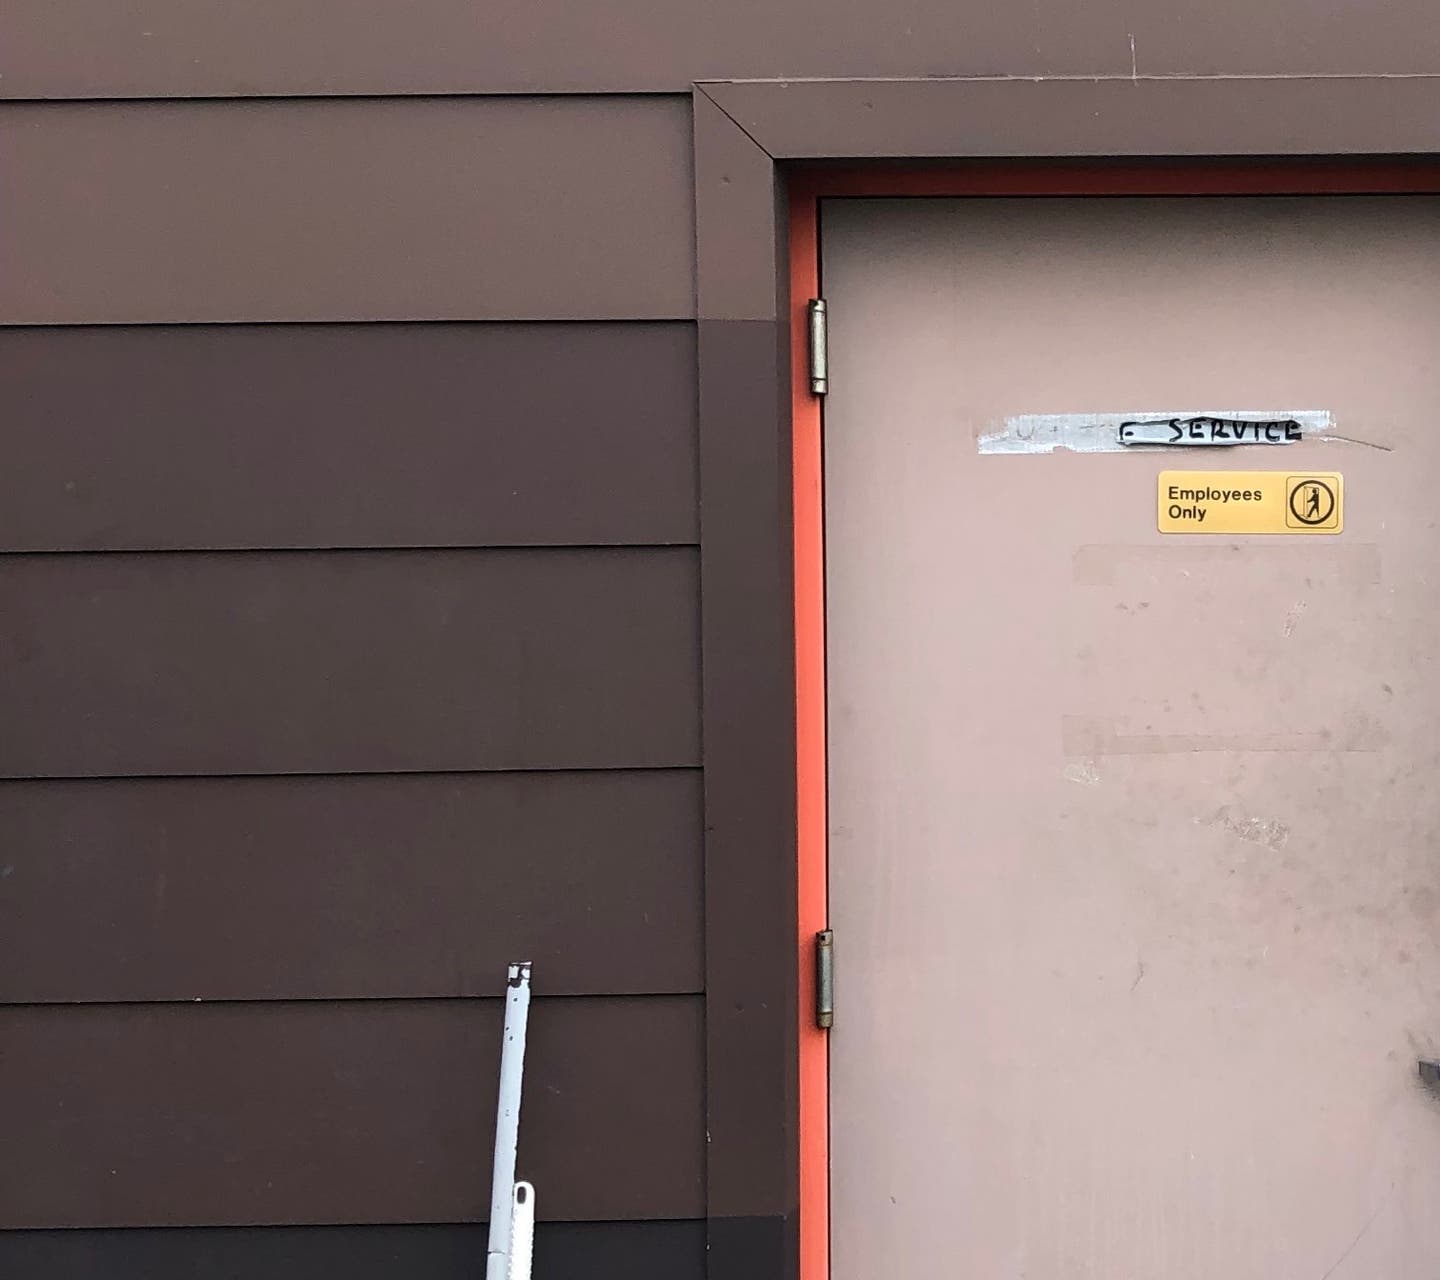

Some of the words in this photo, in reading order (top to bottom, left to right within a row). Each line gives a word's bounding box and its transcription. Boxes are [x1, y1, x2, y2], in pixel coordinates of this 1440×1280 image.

[1168, 416, 1302, 443] SERVICE
[1168, 486, 1262, 503] Employees
[1168, 504, 1207, 522] Only
